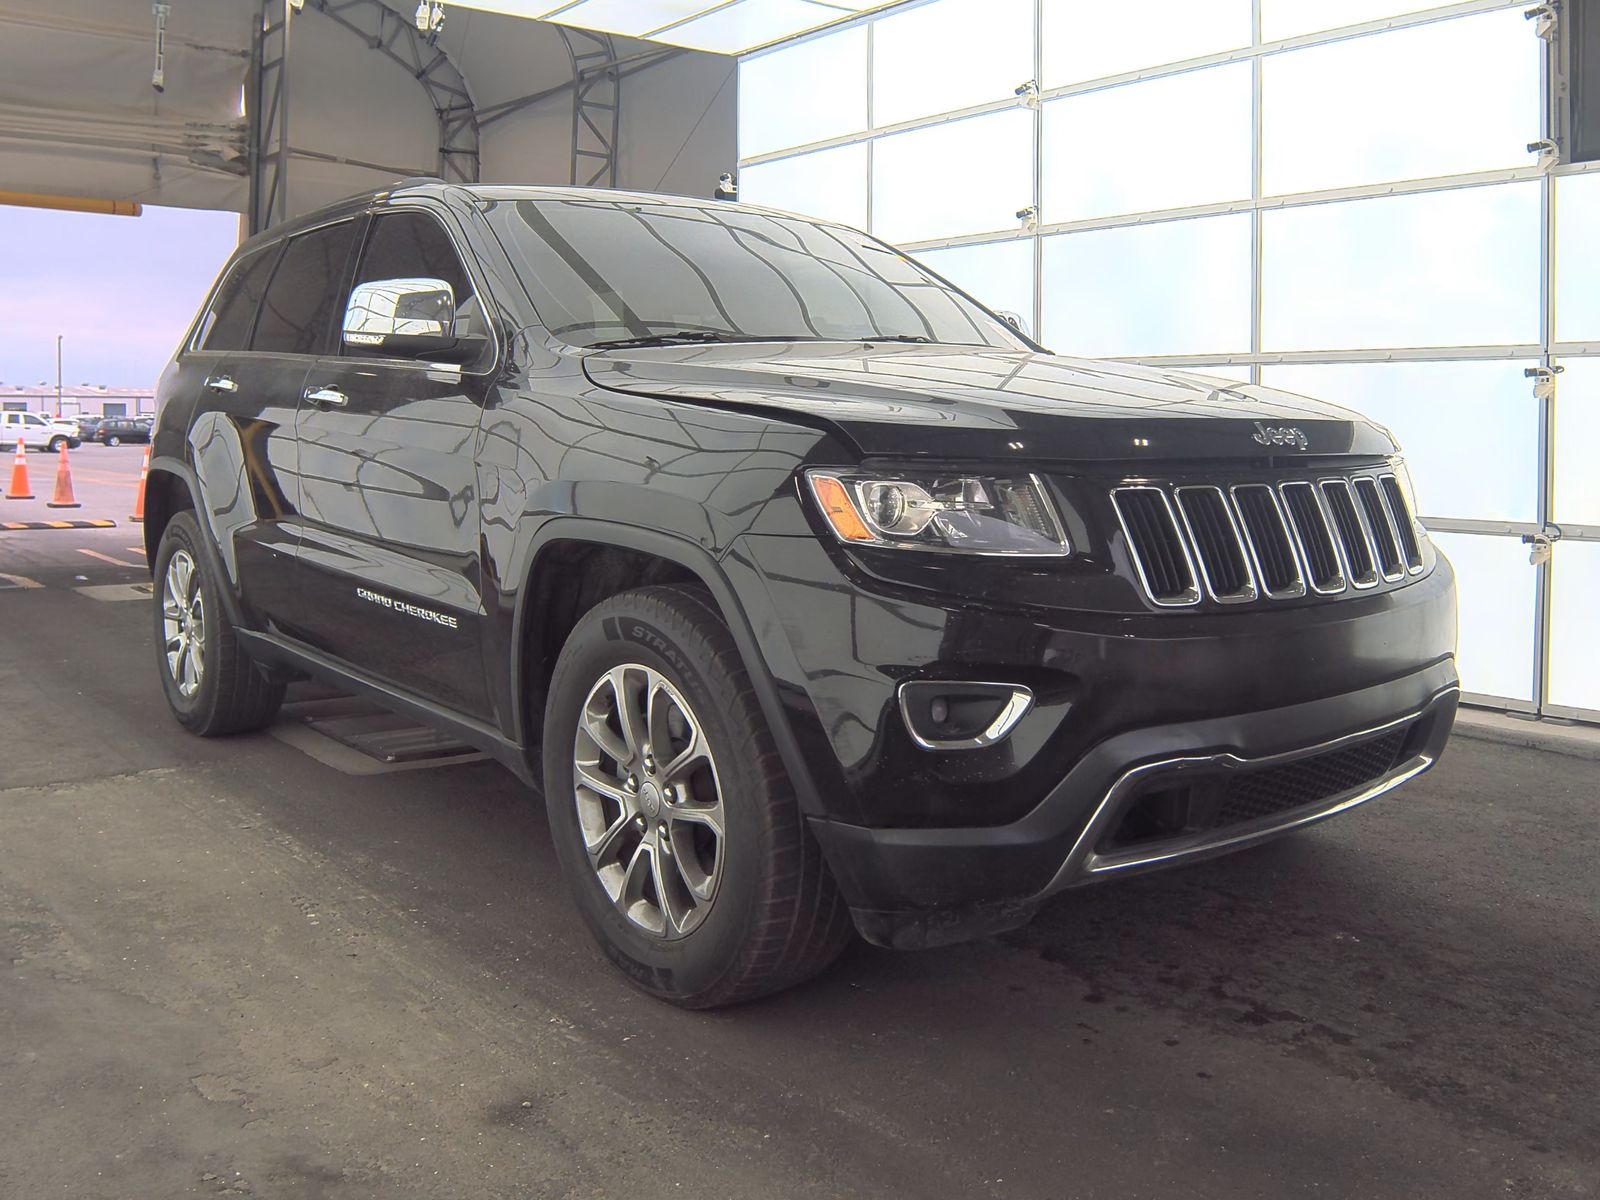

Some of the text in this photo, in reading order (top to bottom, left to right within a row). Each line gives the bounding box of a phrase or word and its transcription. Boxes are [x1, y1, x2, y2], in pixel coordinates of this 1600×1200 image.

[1252, 421, 1308, 450] Jeep
[356, 587, 458, 628] GRAND CHEROKEE
